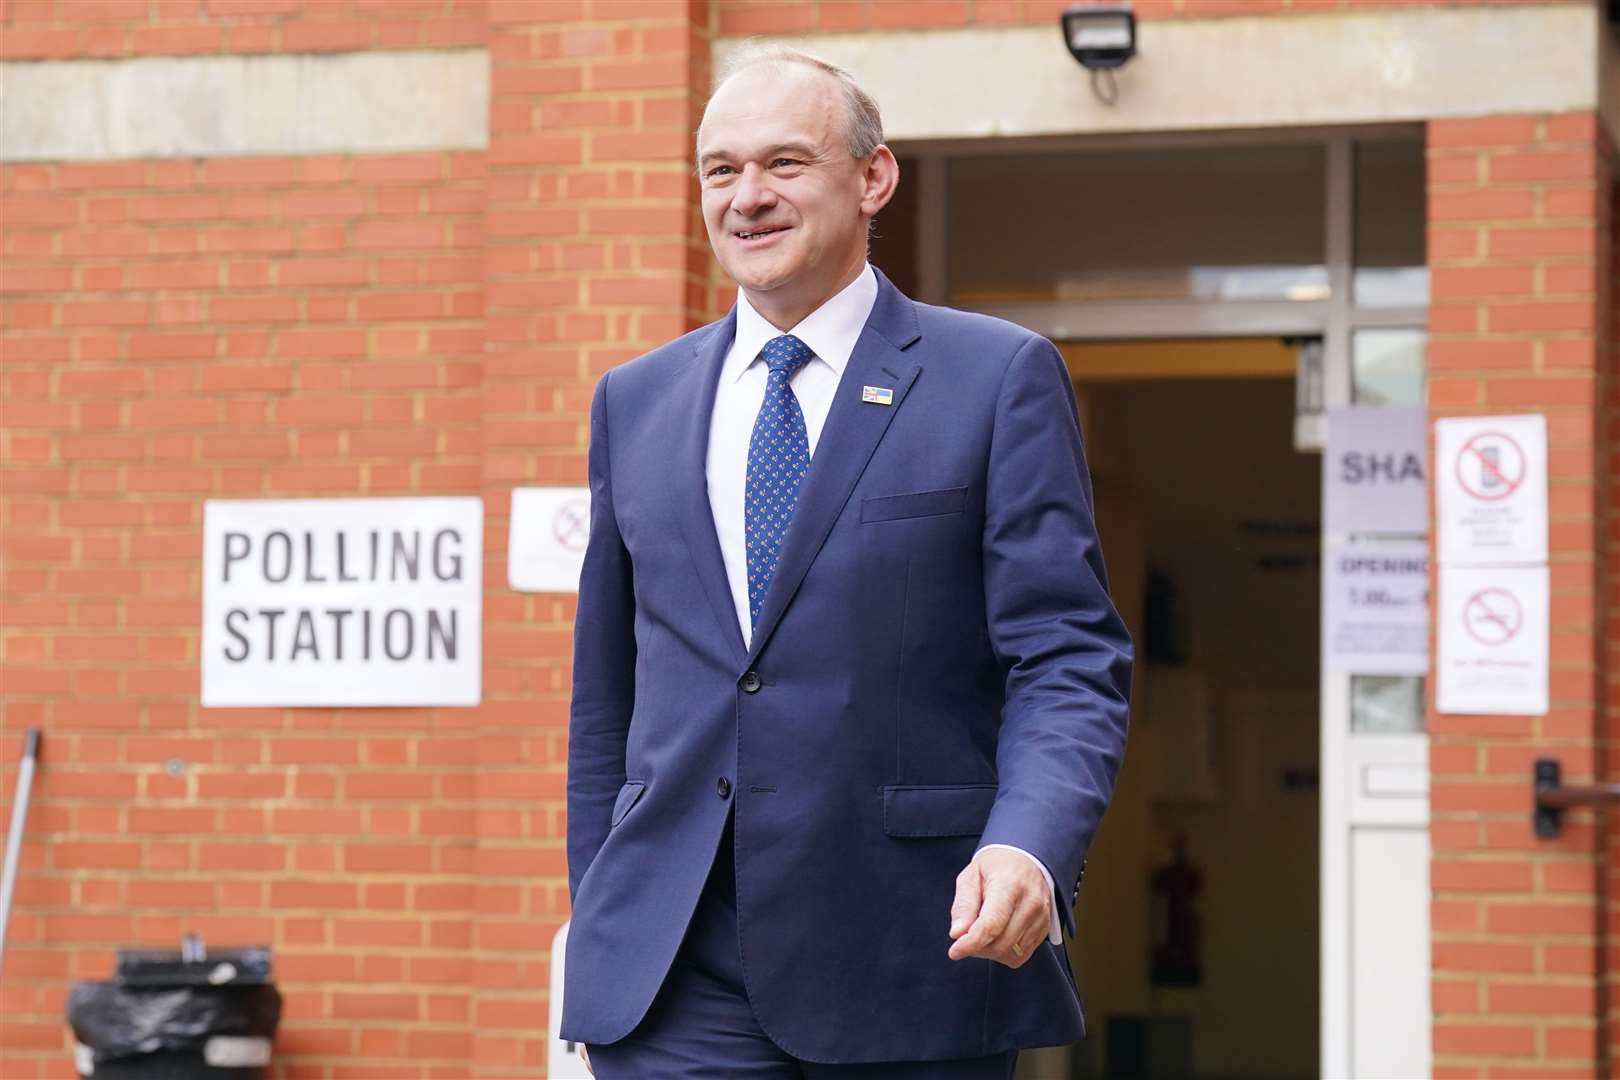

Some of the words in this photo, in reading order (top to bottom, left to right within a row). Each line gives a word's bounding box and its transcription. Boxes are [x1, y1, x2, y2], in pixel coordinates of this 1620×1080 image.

[1341, 451, 1425, 484] SHA
[221, 528, 463, 583] POLLING
[223, 608, 459, 662] STATION
